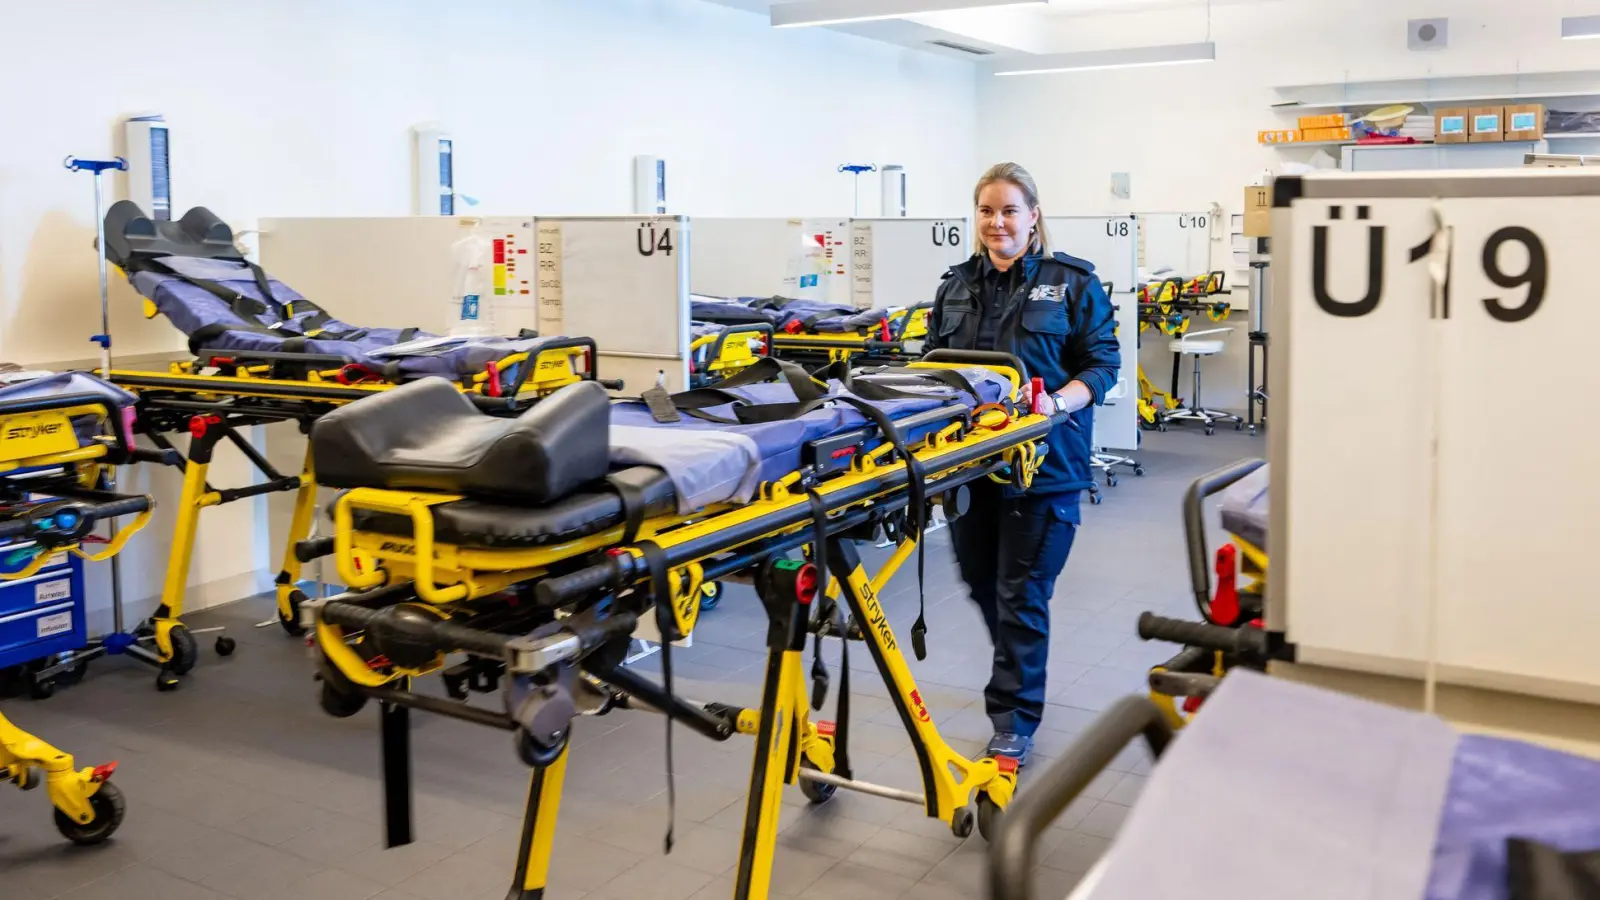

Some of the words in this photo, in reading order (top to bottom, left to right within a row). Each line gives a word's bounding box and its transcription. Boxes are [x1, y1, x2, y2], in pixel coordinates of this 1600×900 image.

[637, 222, 673, 256] Ü4
[932, 222, 960, 247] Ü6
[1106, 219, 1128, 237] Ü8
[7, 423, 64, 440] stryker
[859, 583, 897, 651] stryker
